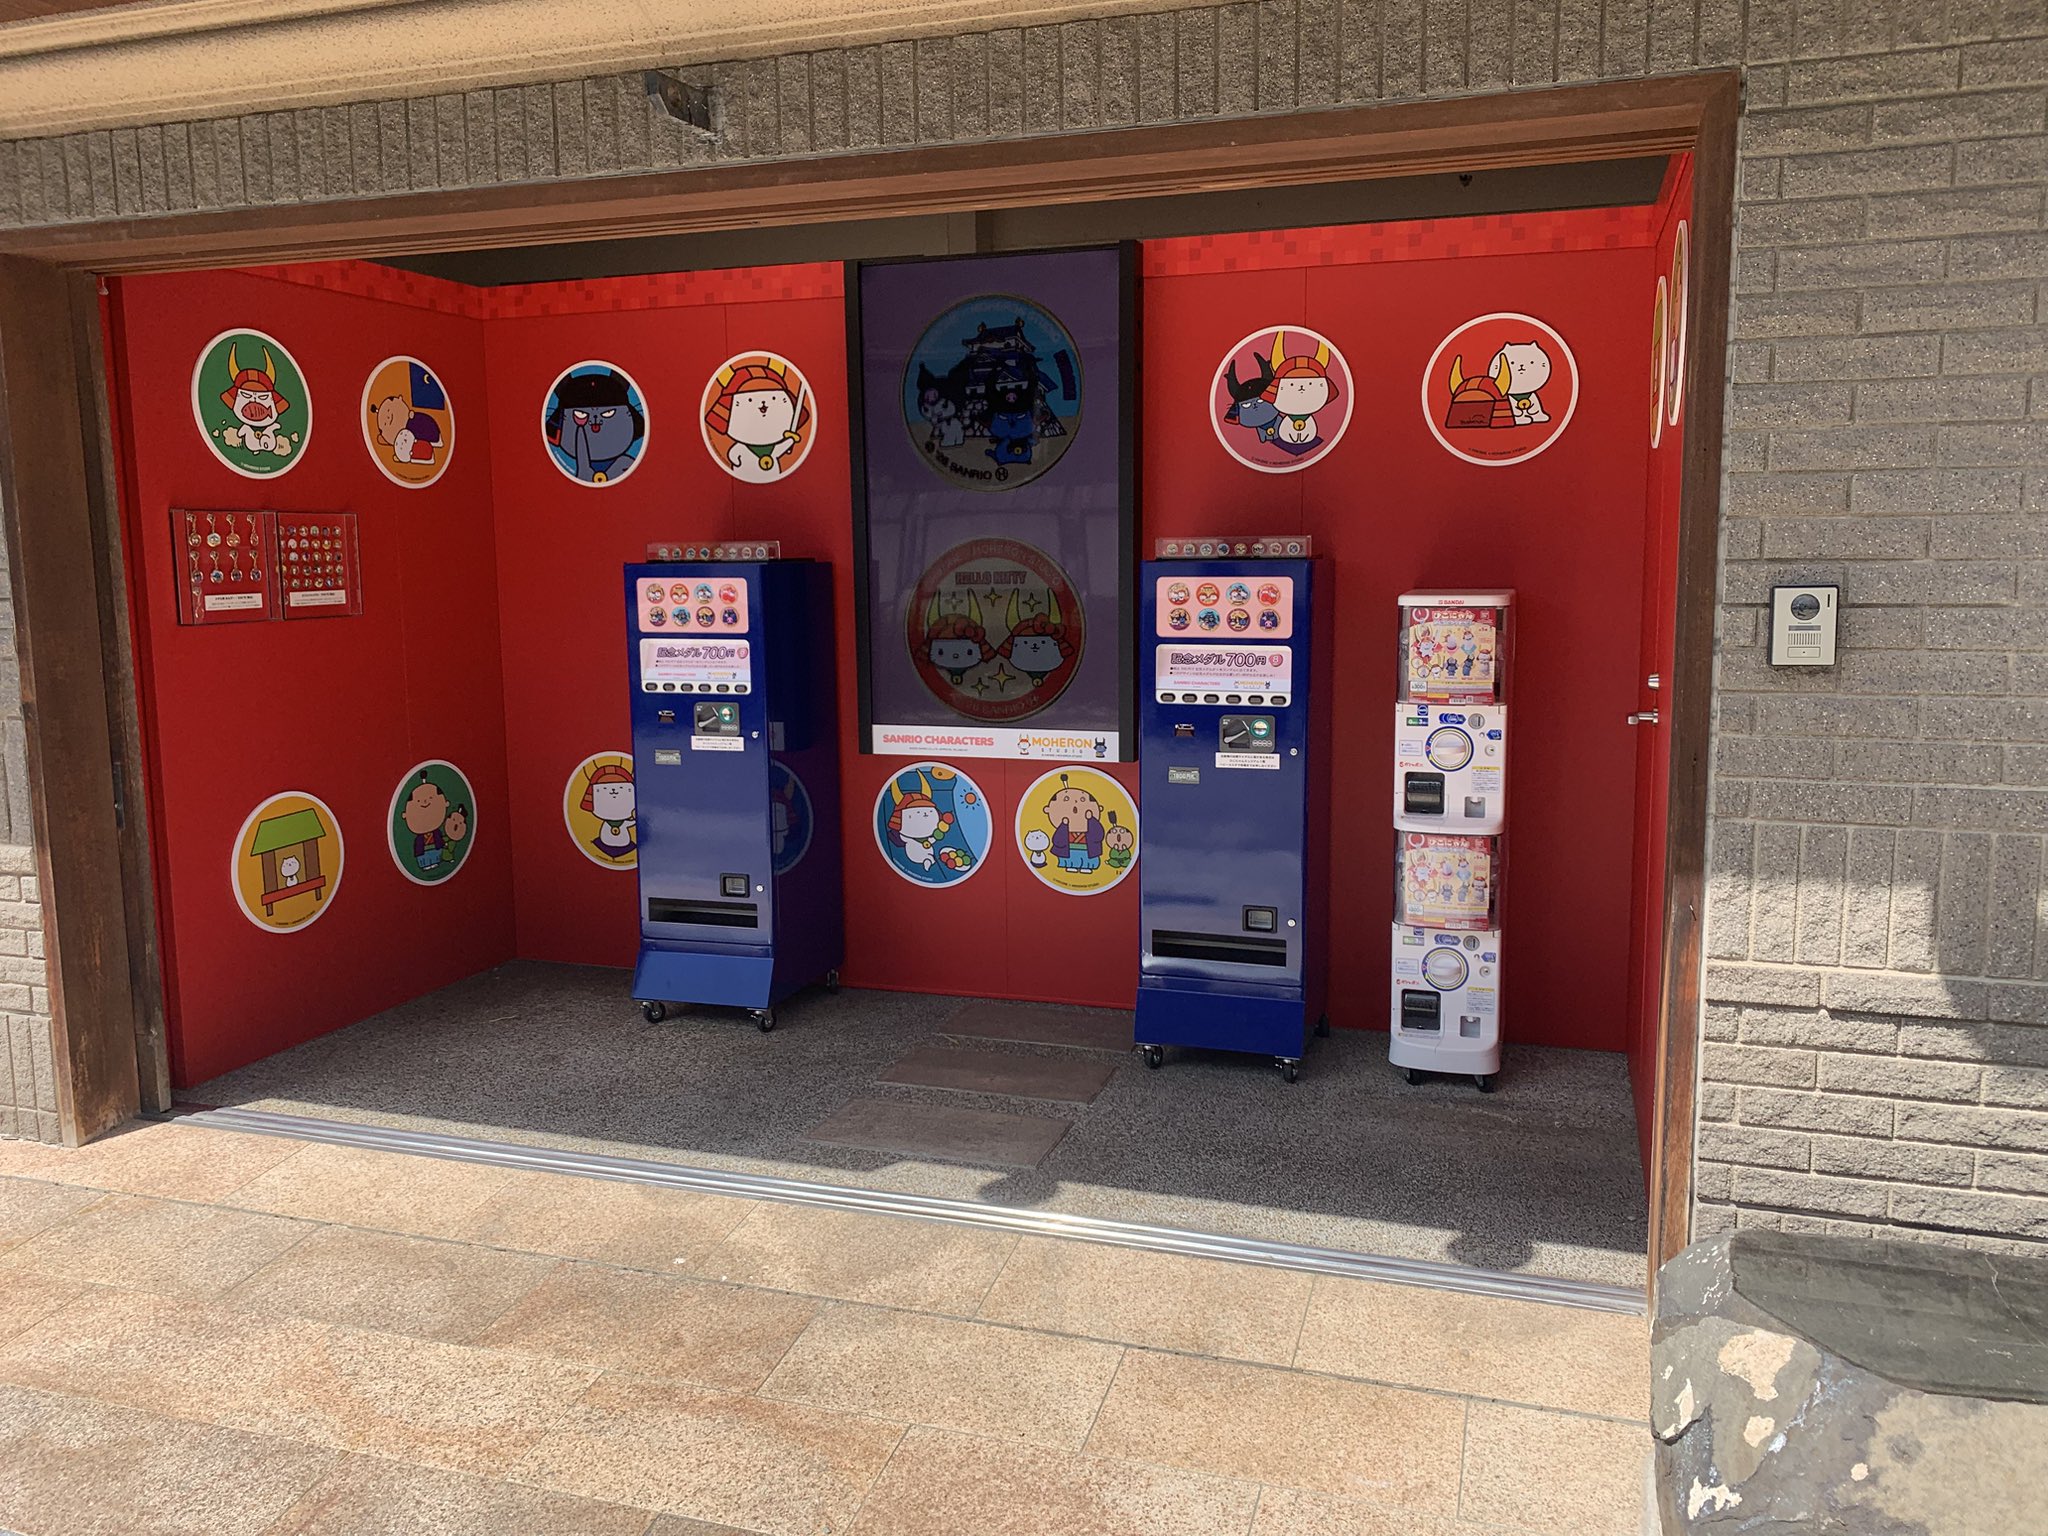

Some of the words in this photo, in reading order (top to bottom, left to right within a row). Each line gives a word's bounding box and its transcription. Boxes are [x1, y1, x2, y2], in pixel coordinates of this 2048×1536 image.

[950, 462, 993, 480] SANRIO
[954, 571, 992, 585] HELLO
[993, 571, 1027, 585] KITTY
[1171, 653, 1267, 667] 記念メダル700円
[882, 734, 922, 744] SANRIO
[924, 735, 994, 746] CHARACTERS
[1031, 736, 1093, 748] MOHERON
